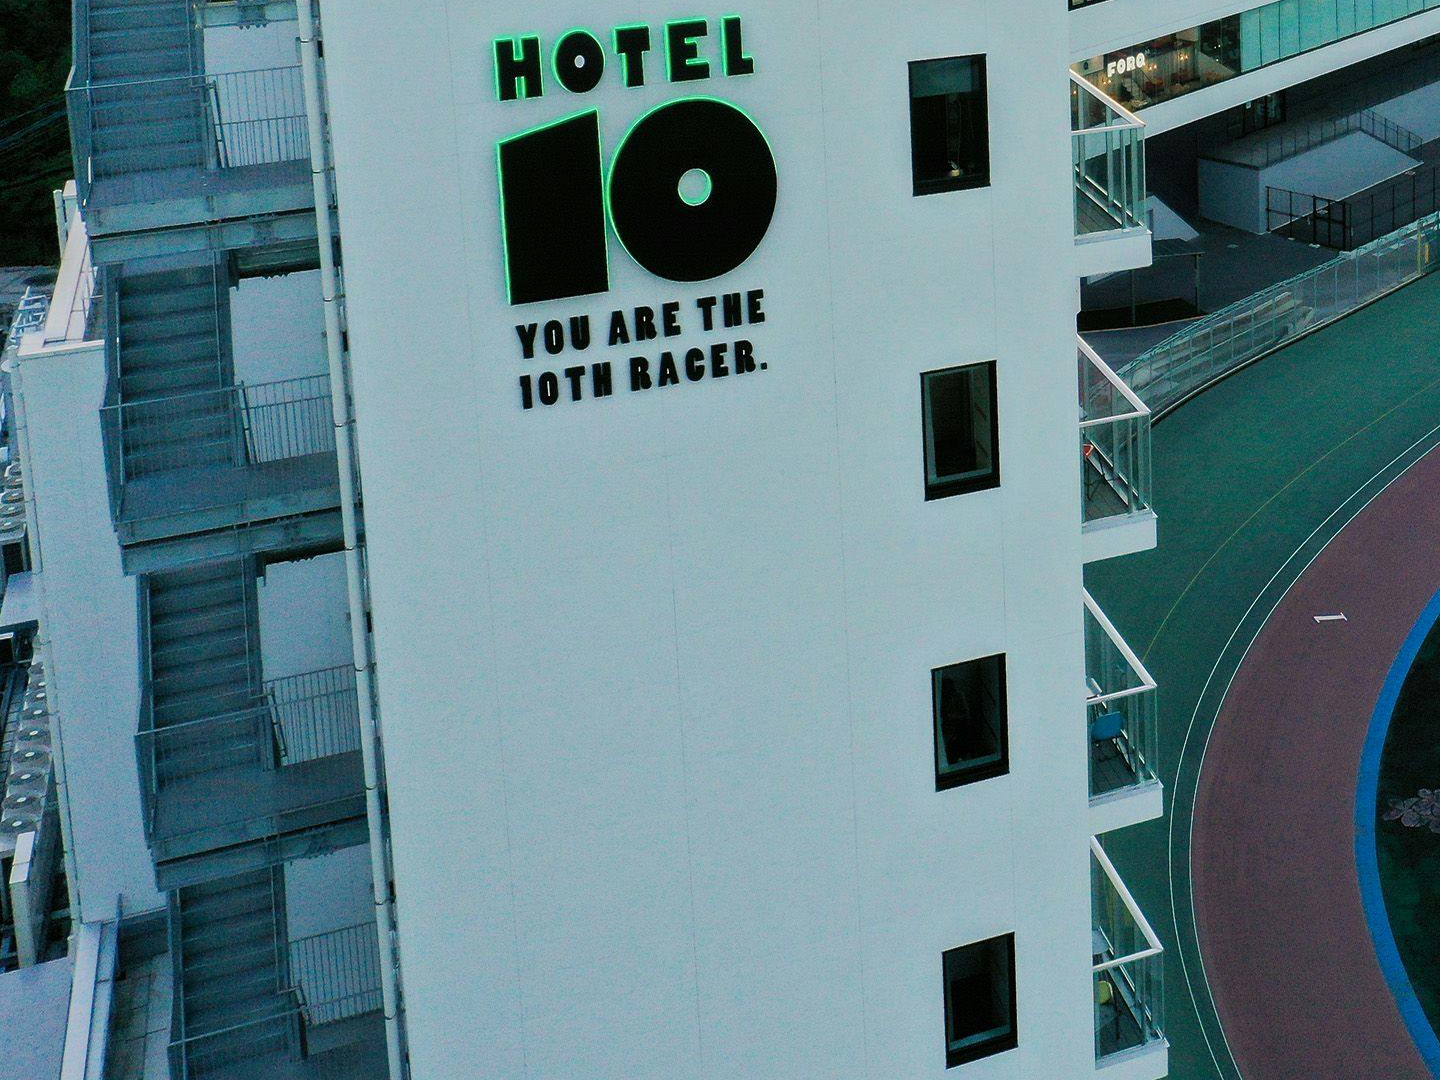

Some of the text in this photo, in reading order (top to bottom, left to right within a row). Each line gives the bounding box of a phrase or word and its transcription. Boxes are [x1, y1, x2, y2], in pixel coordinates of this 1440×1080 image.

[493, 15, 754, 101] HOTEL
[498, 94, 778, 306] 10
[515, 289, 766, 360] YOU ARE THE
[519, 340, 768, 410] 10TH RACER.
